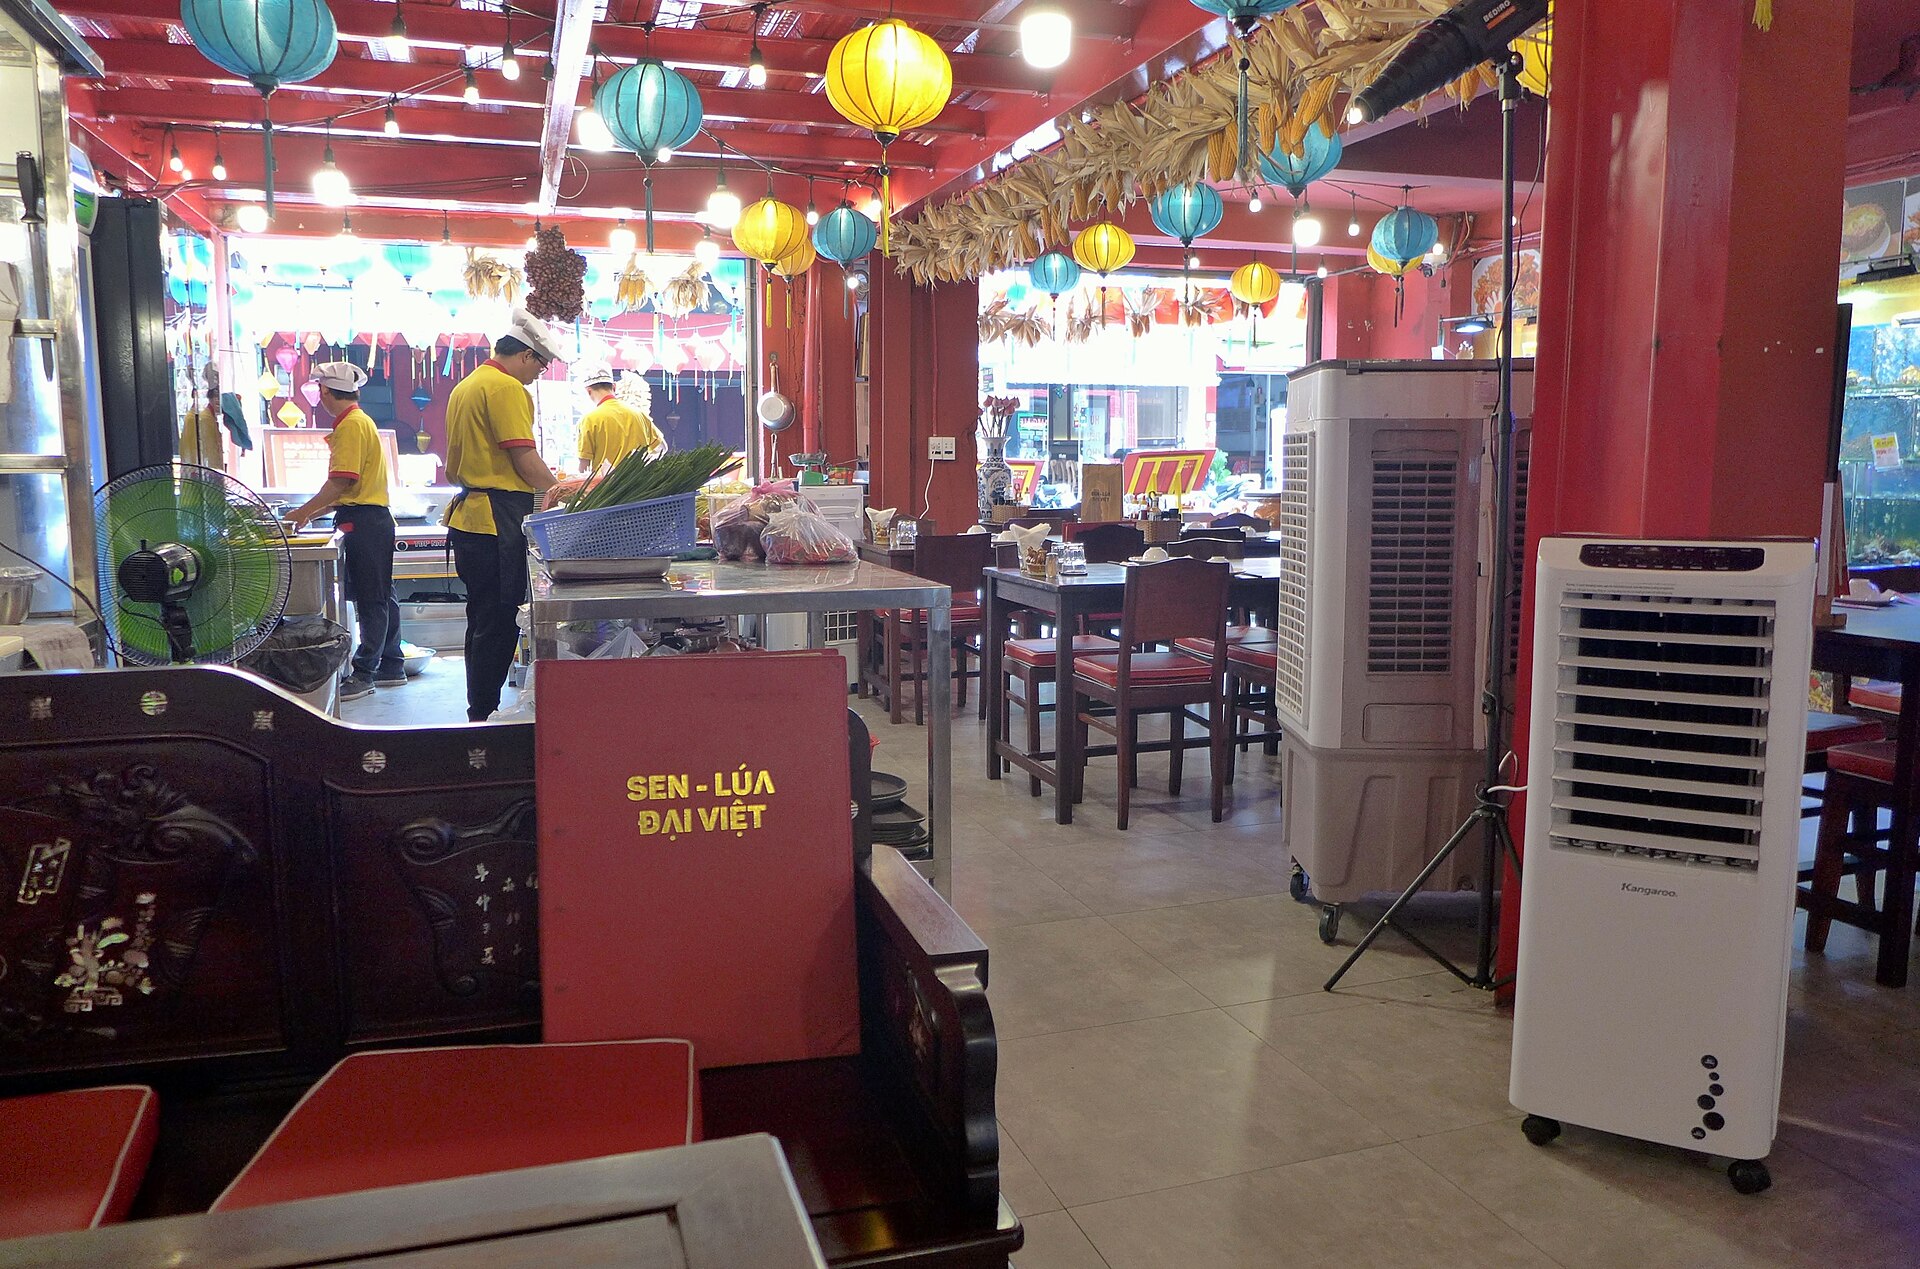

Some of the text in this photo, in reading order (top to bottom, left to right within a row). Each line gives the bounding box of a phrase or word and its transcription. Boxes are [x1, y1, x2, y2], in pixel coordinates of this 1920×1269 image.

[626, 774, 689, 801] SEN
[714, 763, 775, 797] LÚA
[638, 798, 767, 841] ĐẠI VIỆT
